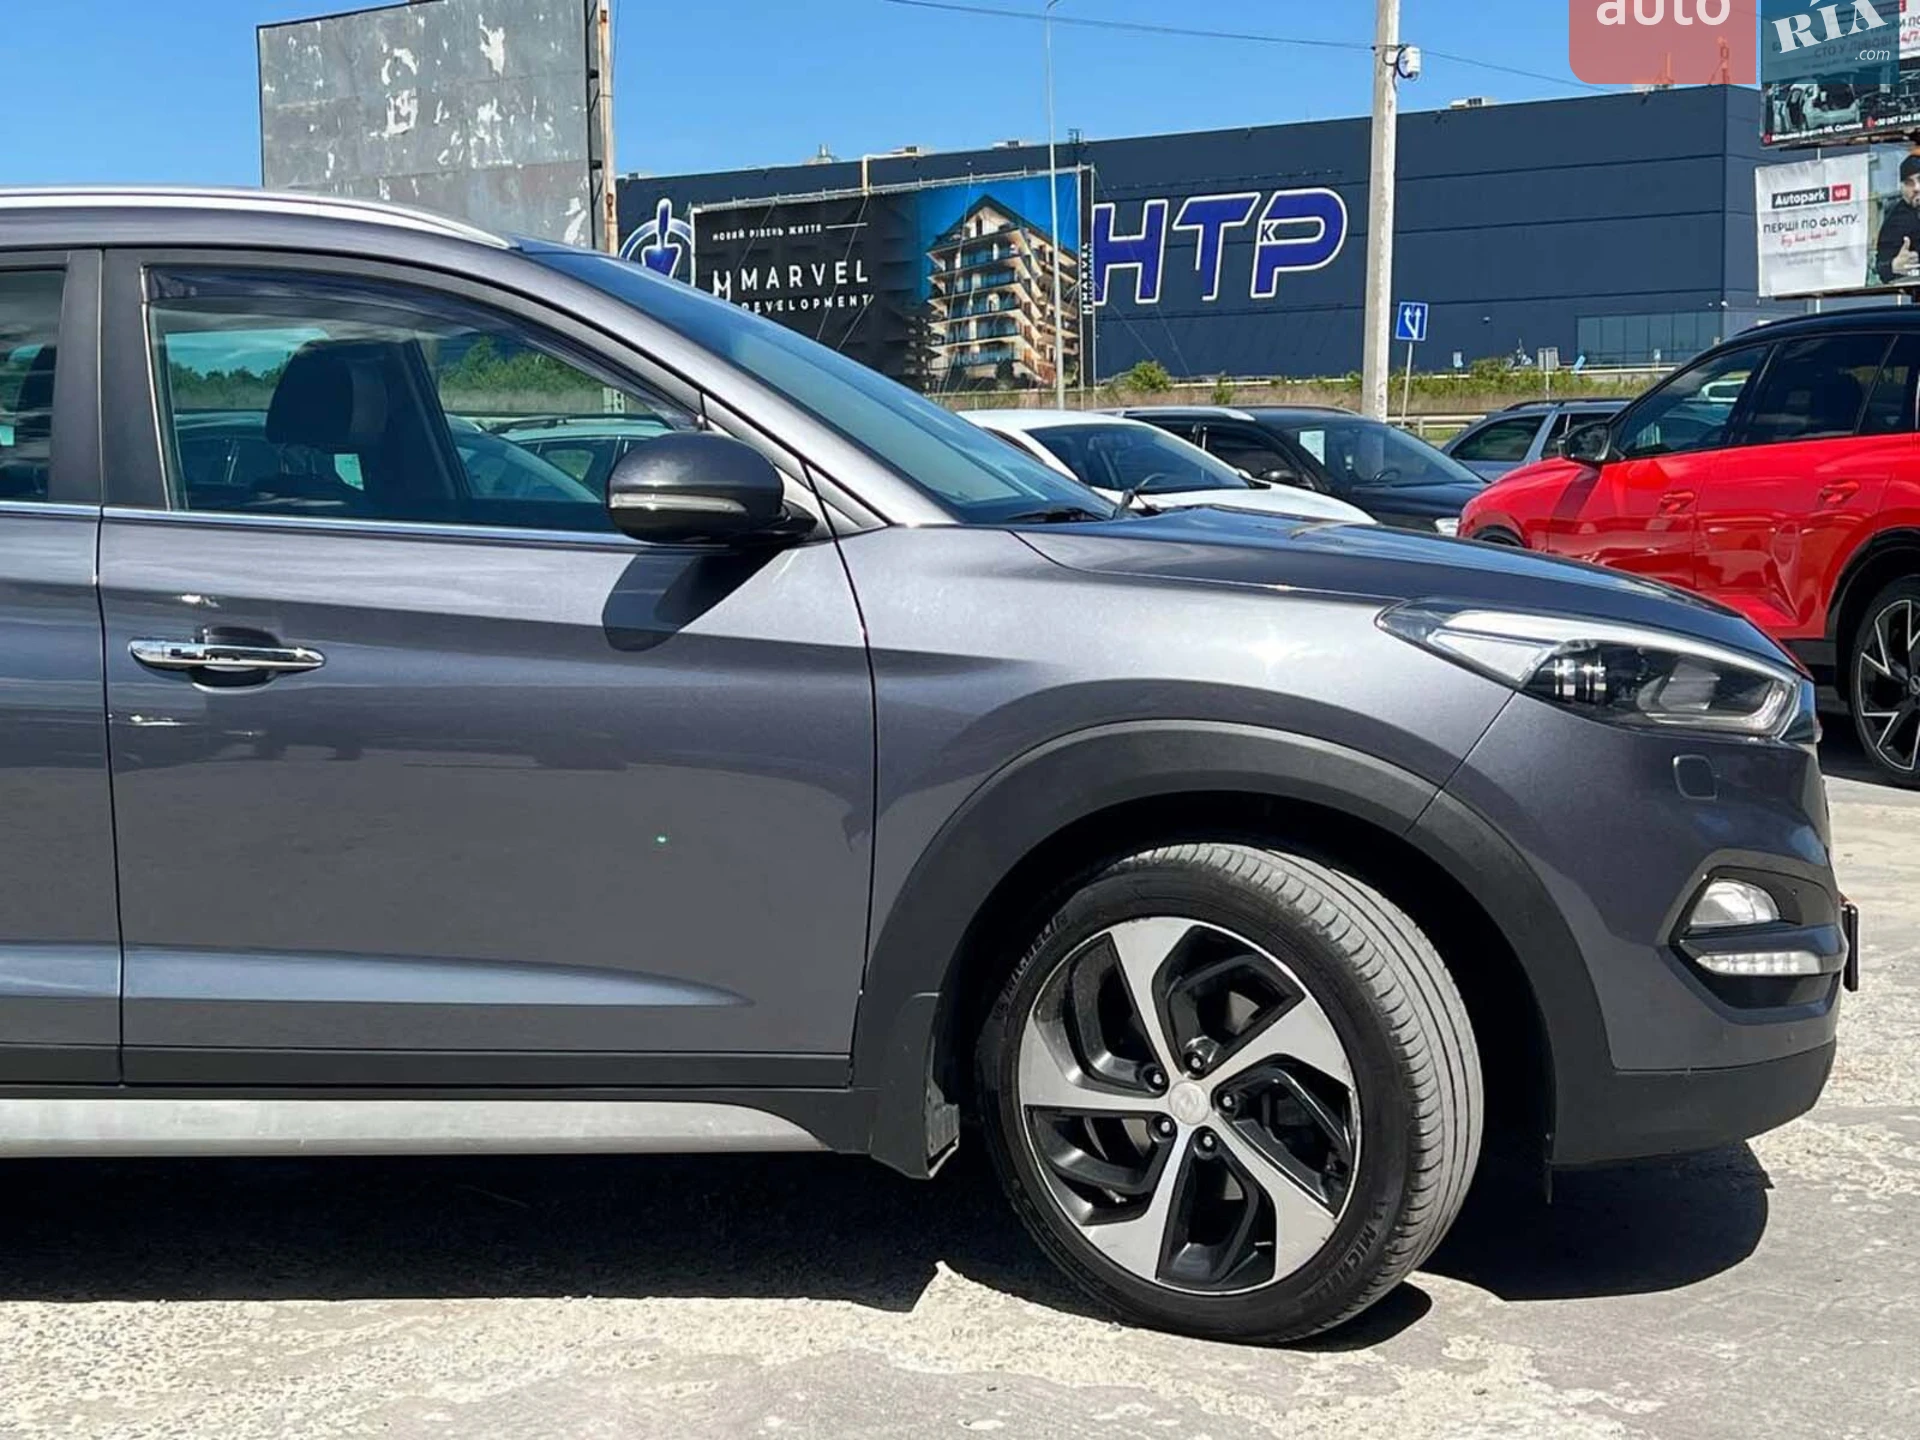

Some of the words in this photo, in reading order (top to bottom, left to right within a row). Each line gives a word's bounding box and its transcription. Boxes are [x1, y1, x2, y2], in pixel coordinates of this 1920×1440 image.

[1774, 187, 1827, 207] Autopark
[712, 228, 745, 242] НОВИЙ
[749, 226, 785, 239] РІВЕНЬ
[788, 223, 822, 236] ЖИТТЯ
[1763, 221, 1799, 234] ПЕРШІ
[1801, 219, 1818, 230] ПО
[740, 259, 869, 292] MARVEL
[741, 294, 872, 315] DEVELOPMENT
